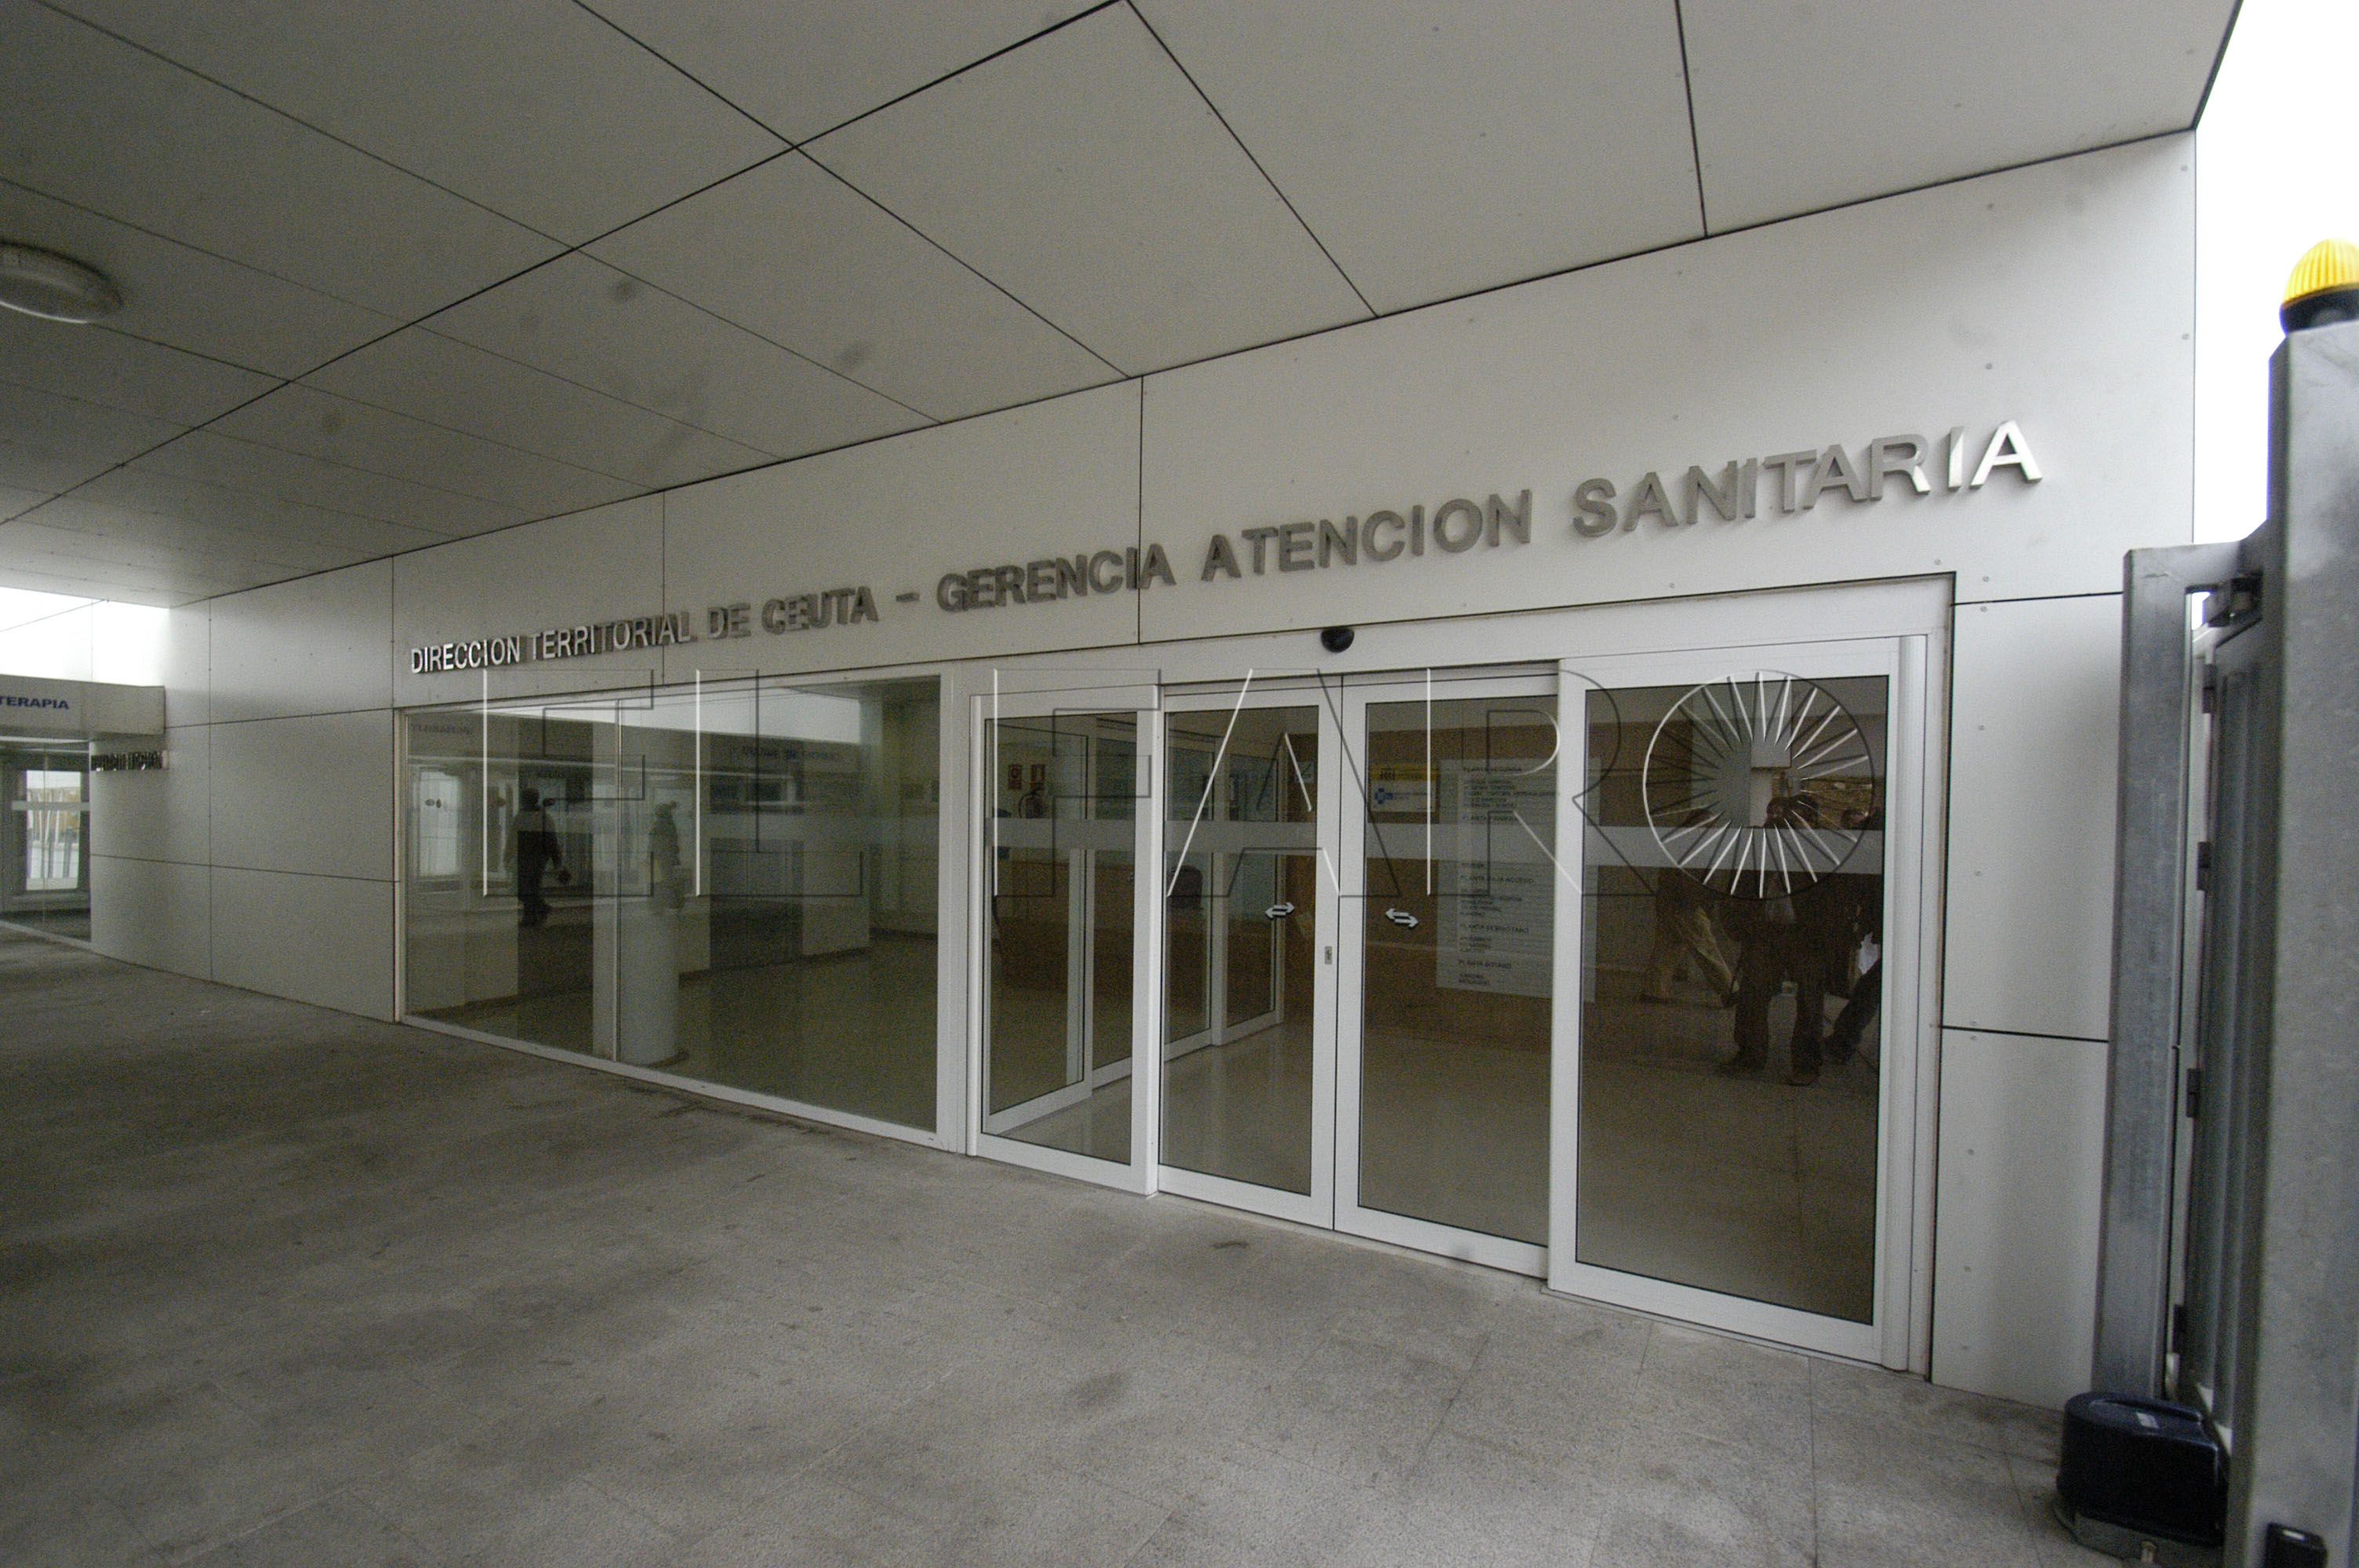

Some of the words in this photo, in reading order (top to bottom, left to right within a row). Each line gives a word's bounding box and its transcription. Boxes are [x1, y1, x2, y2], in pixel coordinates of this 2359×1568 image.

[410, 635, 524, 674] DIRECCION
[529, 611, 696, 661] TERRITORIAL
[707, 602, 751, 639] DE
[761, 586, 880, 635] CEUTA
[936, 543, 1176, 612] GERENCIA
[1201, 489, 1532, 582] ATENCION
[1572, 419, 2042, 538] SANITARIA
